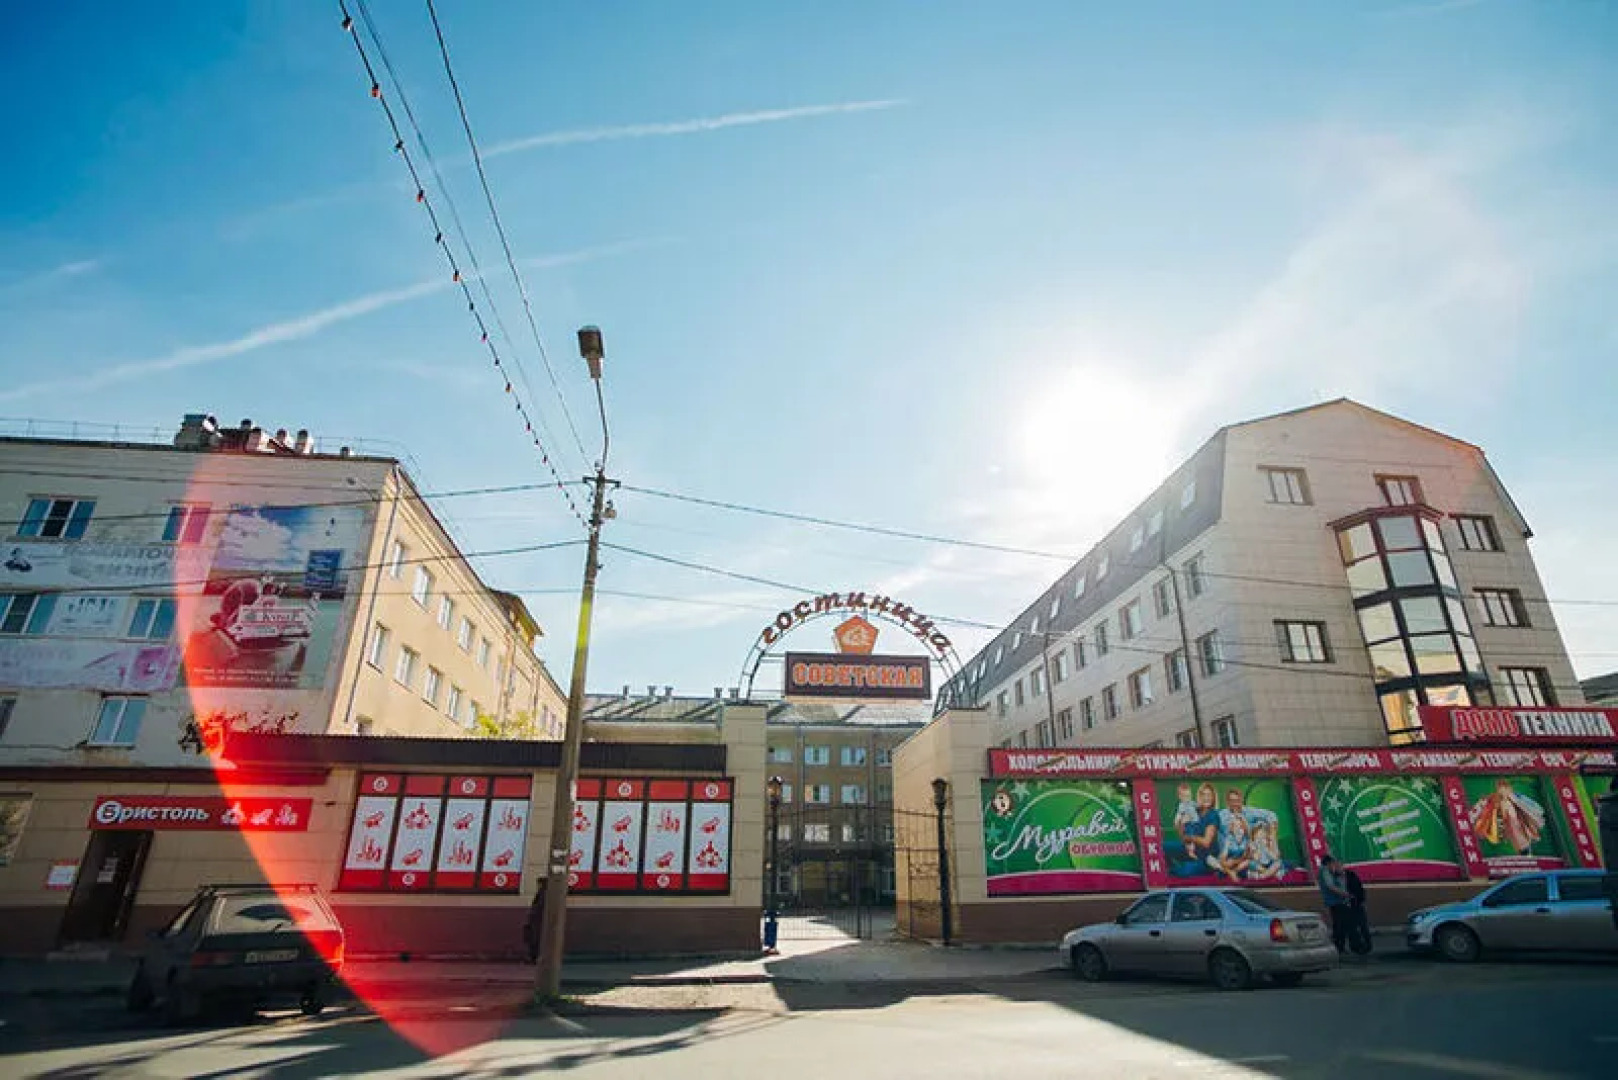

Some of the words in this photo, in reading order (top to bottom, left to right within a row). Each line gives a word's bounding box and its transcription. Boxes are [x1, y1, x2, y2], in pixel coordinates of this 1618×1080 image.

[792, 662, 923, 688] СОВЕТСКАЯ
[96, 799, 211, 825] Бристоль
[1140, 792, 1162, 872] СУМКИ
